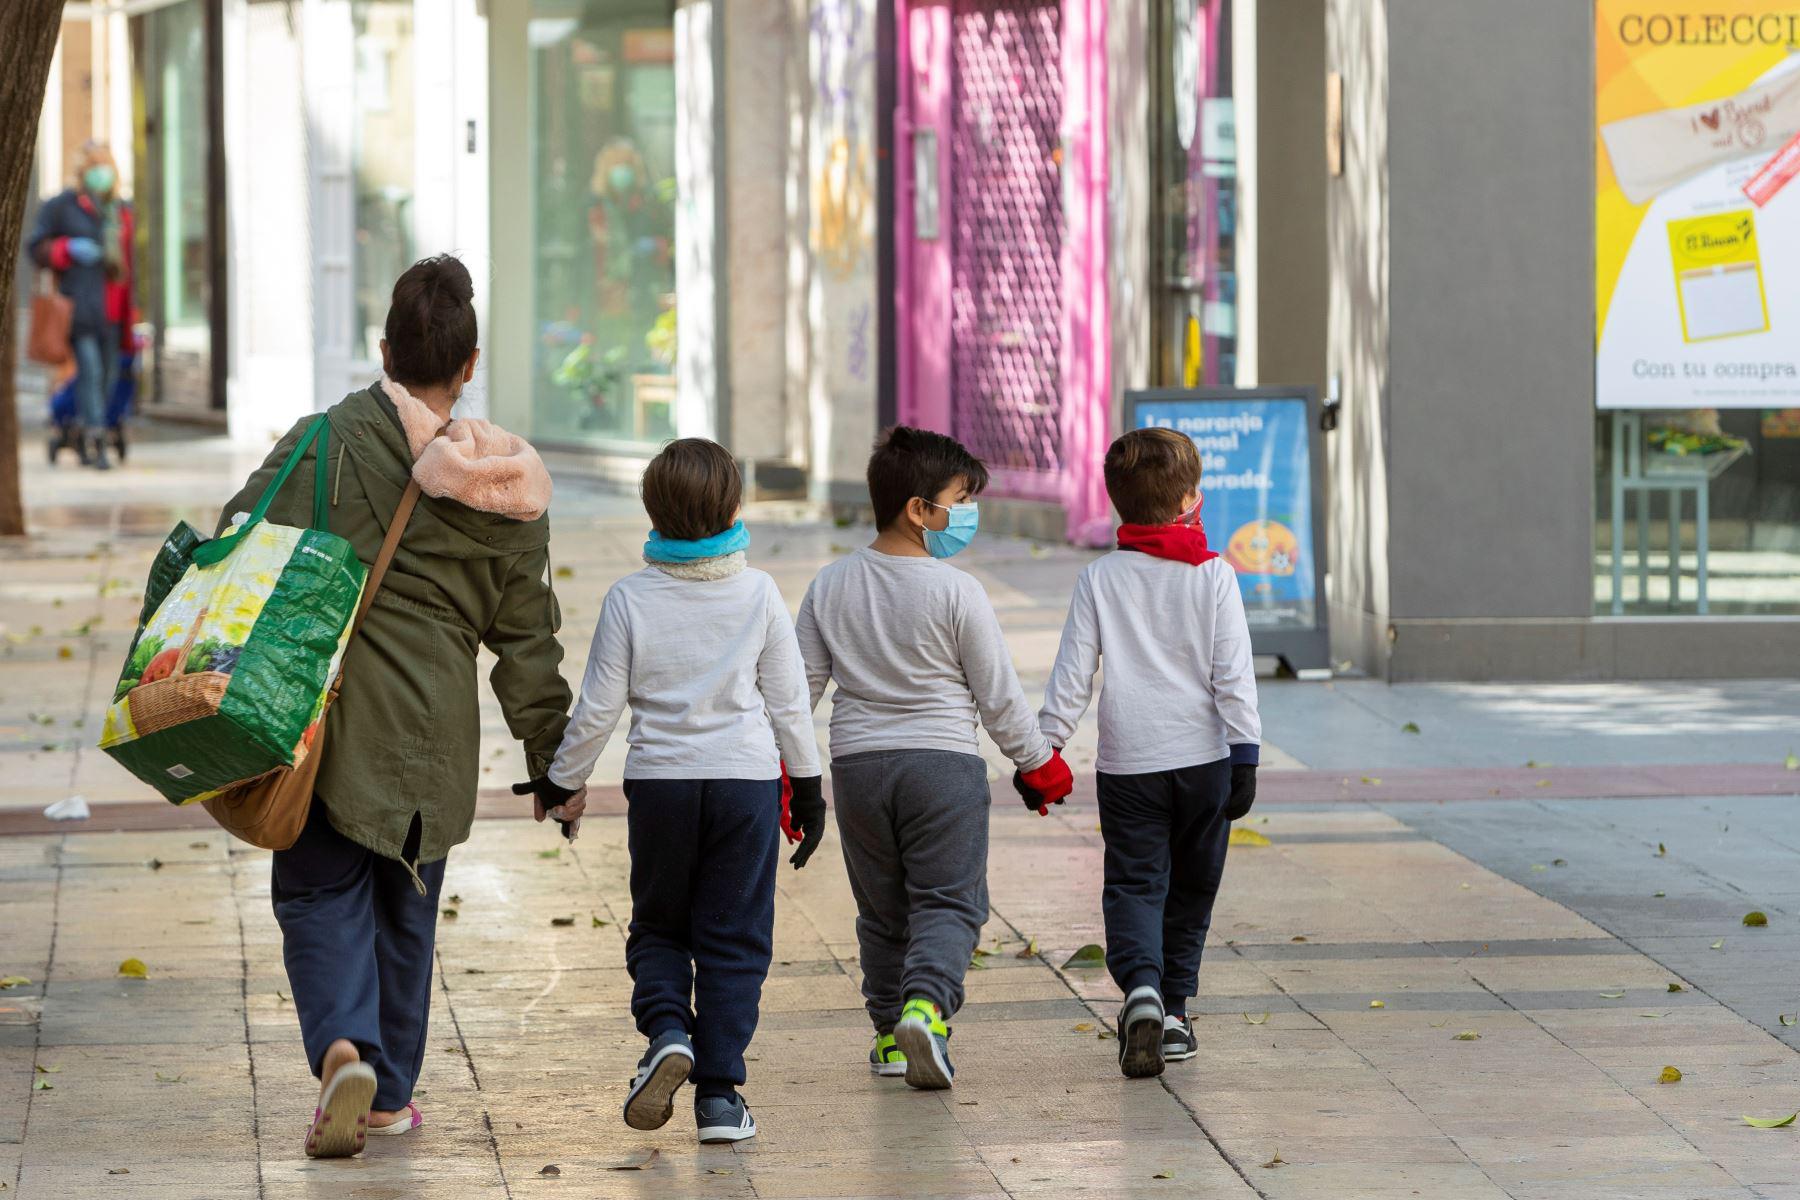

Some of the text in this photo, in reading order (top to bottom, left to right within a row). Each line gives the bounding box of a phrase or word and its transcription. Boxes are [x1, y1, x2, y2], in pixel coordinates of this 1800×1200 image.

[1618, 13, 1800, 46] COLECCI
[1632, 359, 1797, 382] Con tu compra
[1176, 411, 1264, 437] naranja
